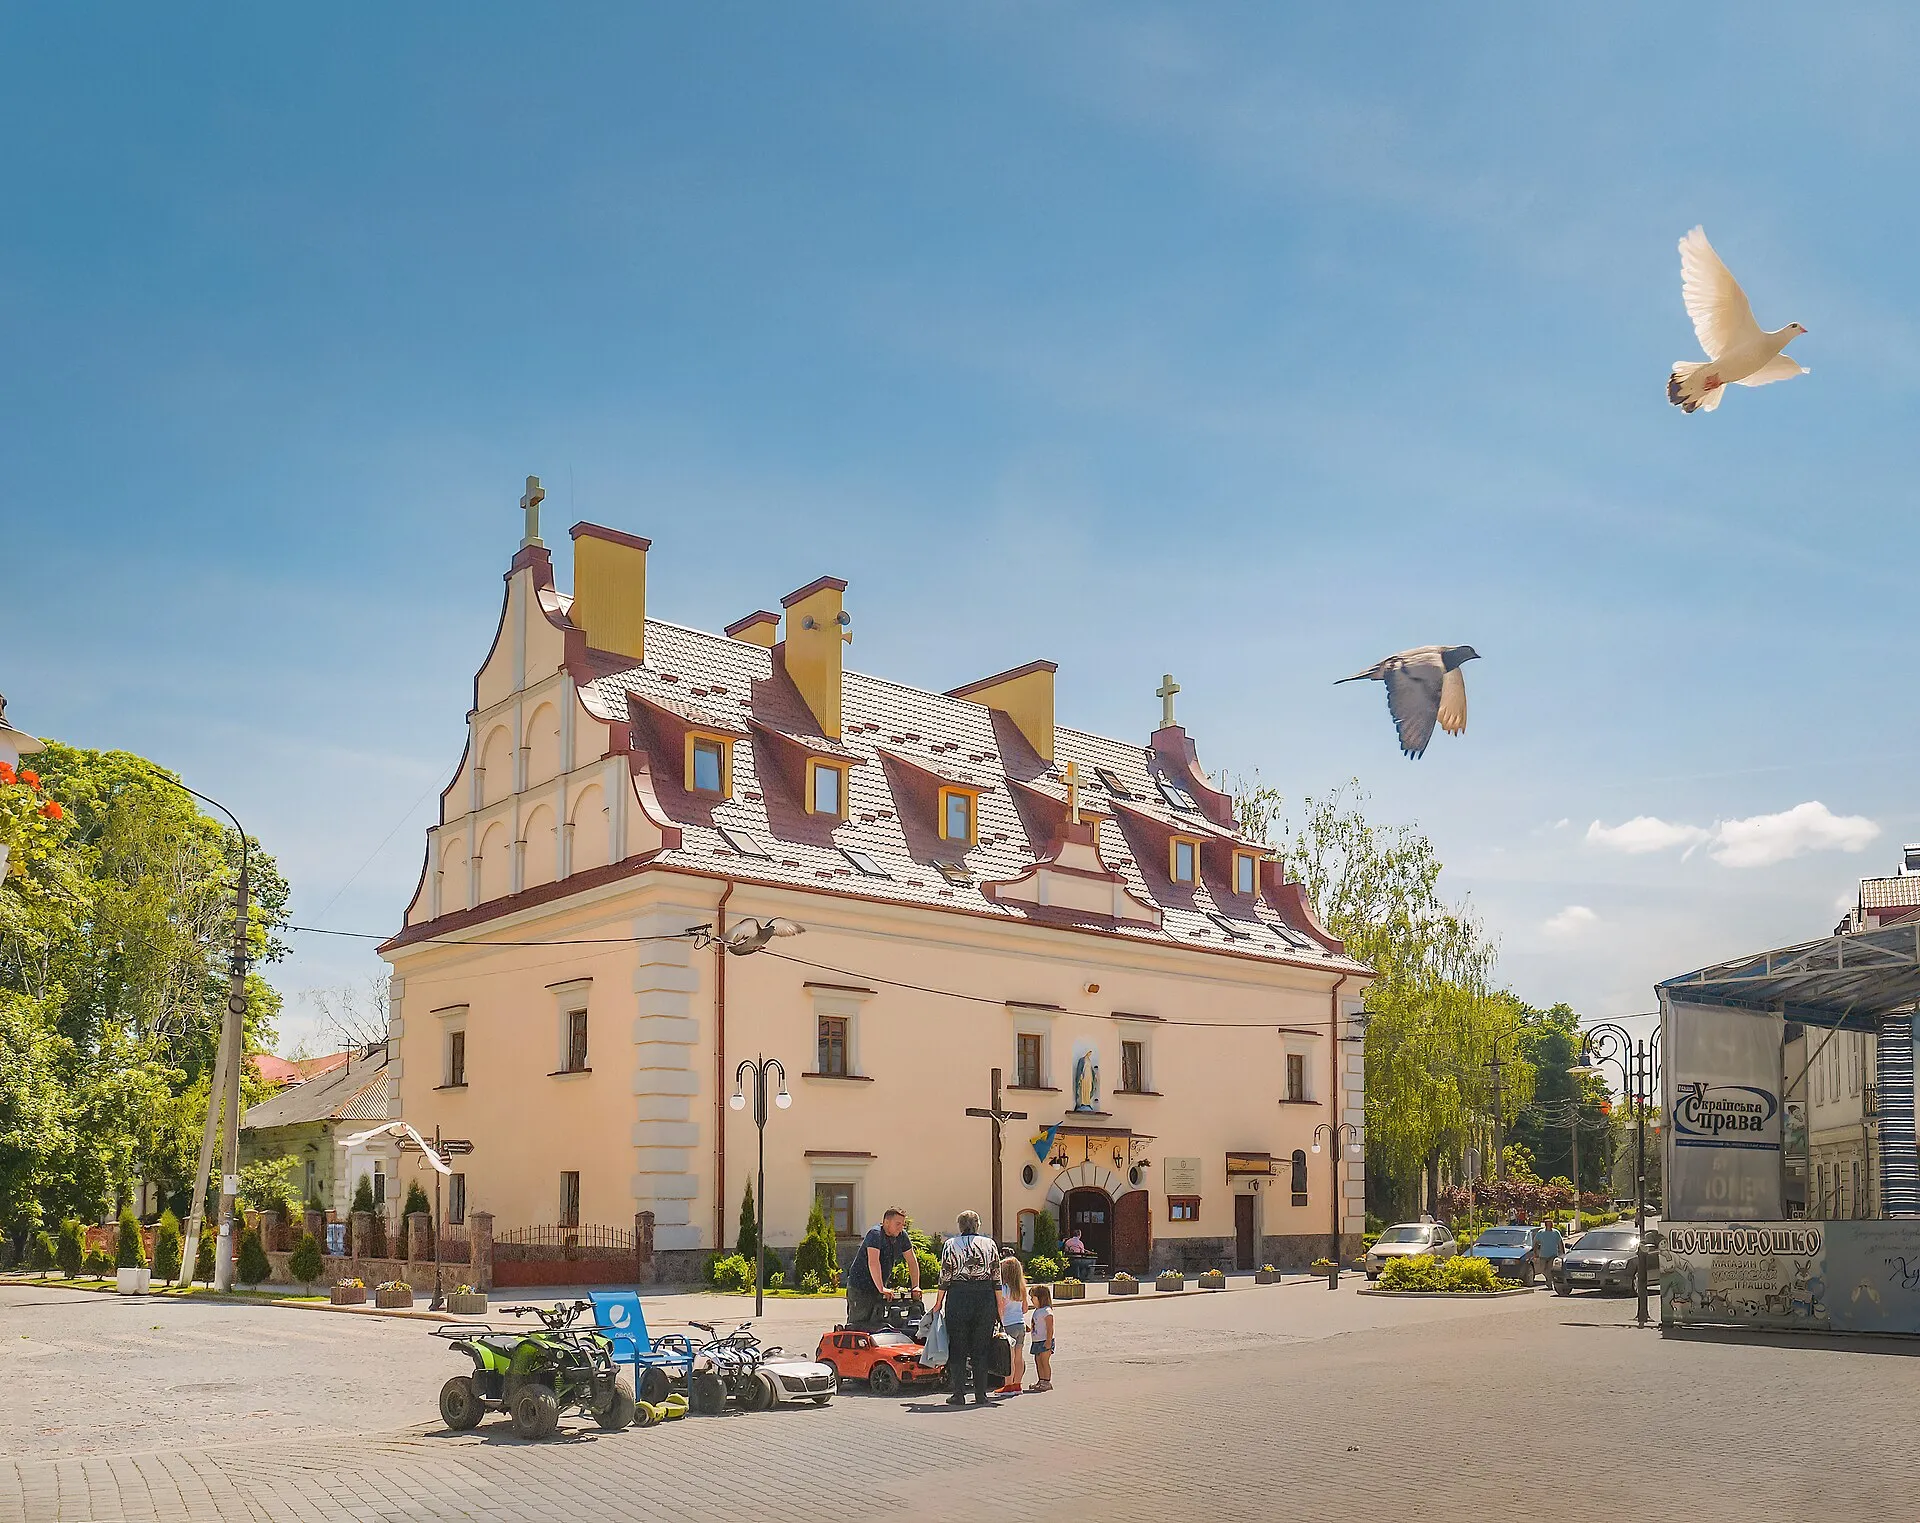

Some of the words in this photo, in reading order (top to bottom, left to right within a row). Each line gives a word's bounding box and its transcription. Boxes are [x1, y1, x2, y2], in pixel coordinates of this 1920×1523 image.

[1692, 1082, 1762, 1113] Українська
[1685, 1096, 1763, 1135] Справа
[1670, 1228, 1821, 1256] КОТИГОРОШКО
[1711, 1259, 1758, 1269] МАГАЗИН
[1734, 1281, 1778, 1290] ІГРАШОК
